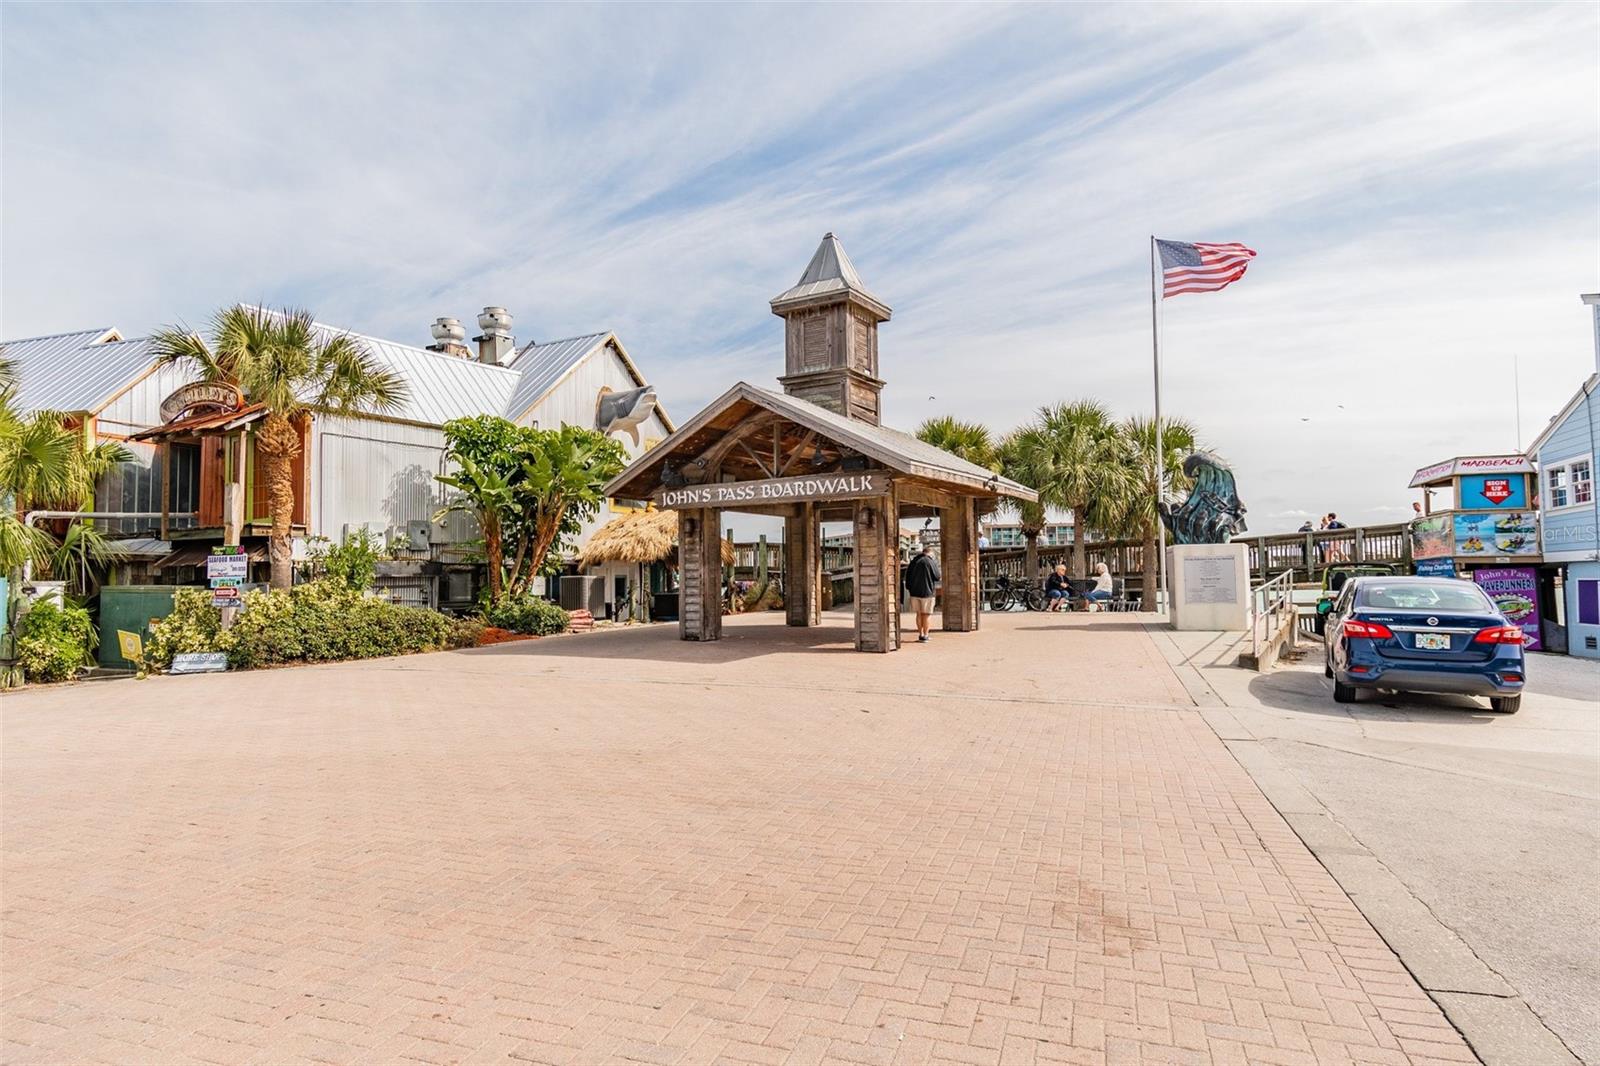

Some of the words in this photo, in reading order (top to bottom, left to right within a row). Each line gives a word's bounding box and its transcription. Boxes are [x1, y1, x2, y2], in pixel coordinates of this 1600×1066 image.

[1461, 458, 1524, 467] MADBEACH
[662, 488, 711, 506] JOHN'S
[718, 485, 755, 501] PASS
[761, 475, 873, 498] BOARDWALK
[1480, 570, 1508, 580] John's
[1510, 569, 1530, 578] Pass
[175, 653, 199, 662] MORE
[200, 652, 225, 662] SHOPS
